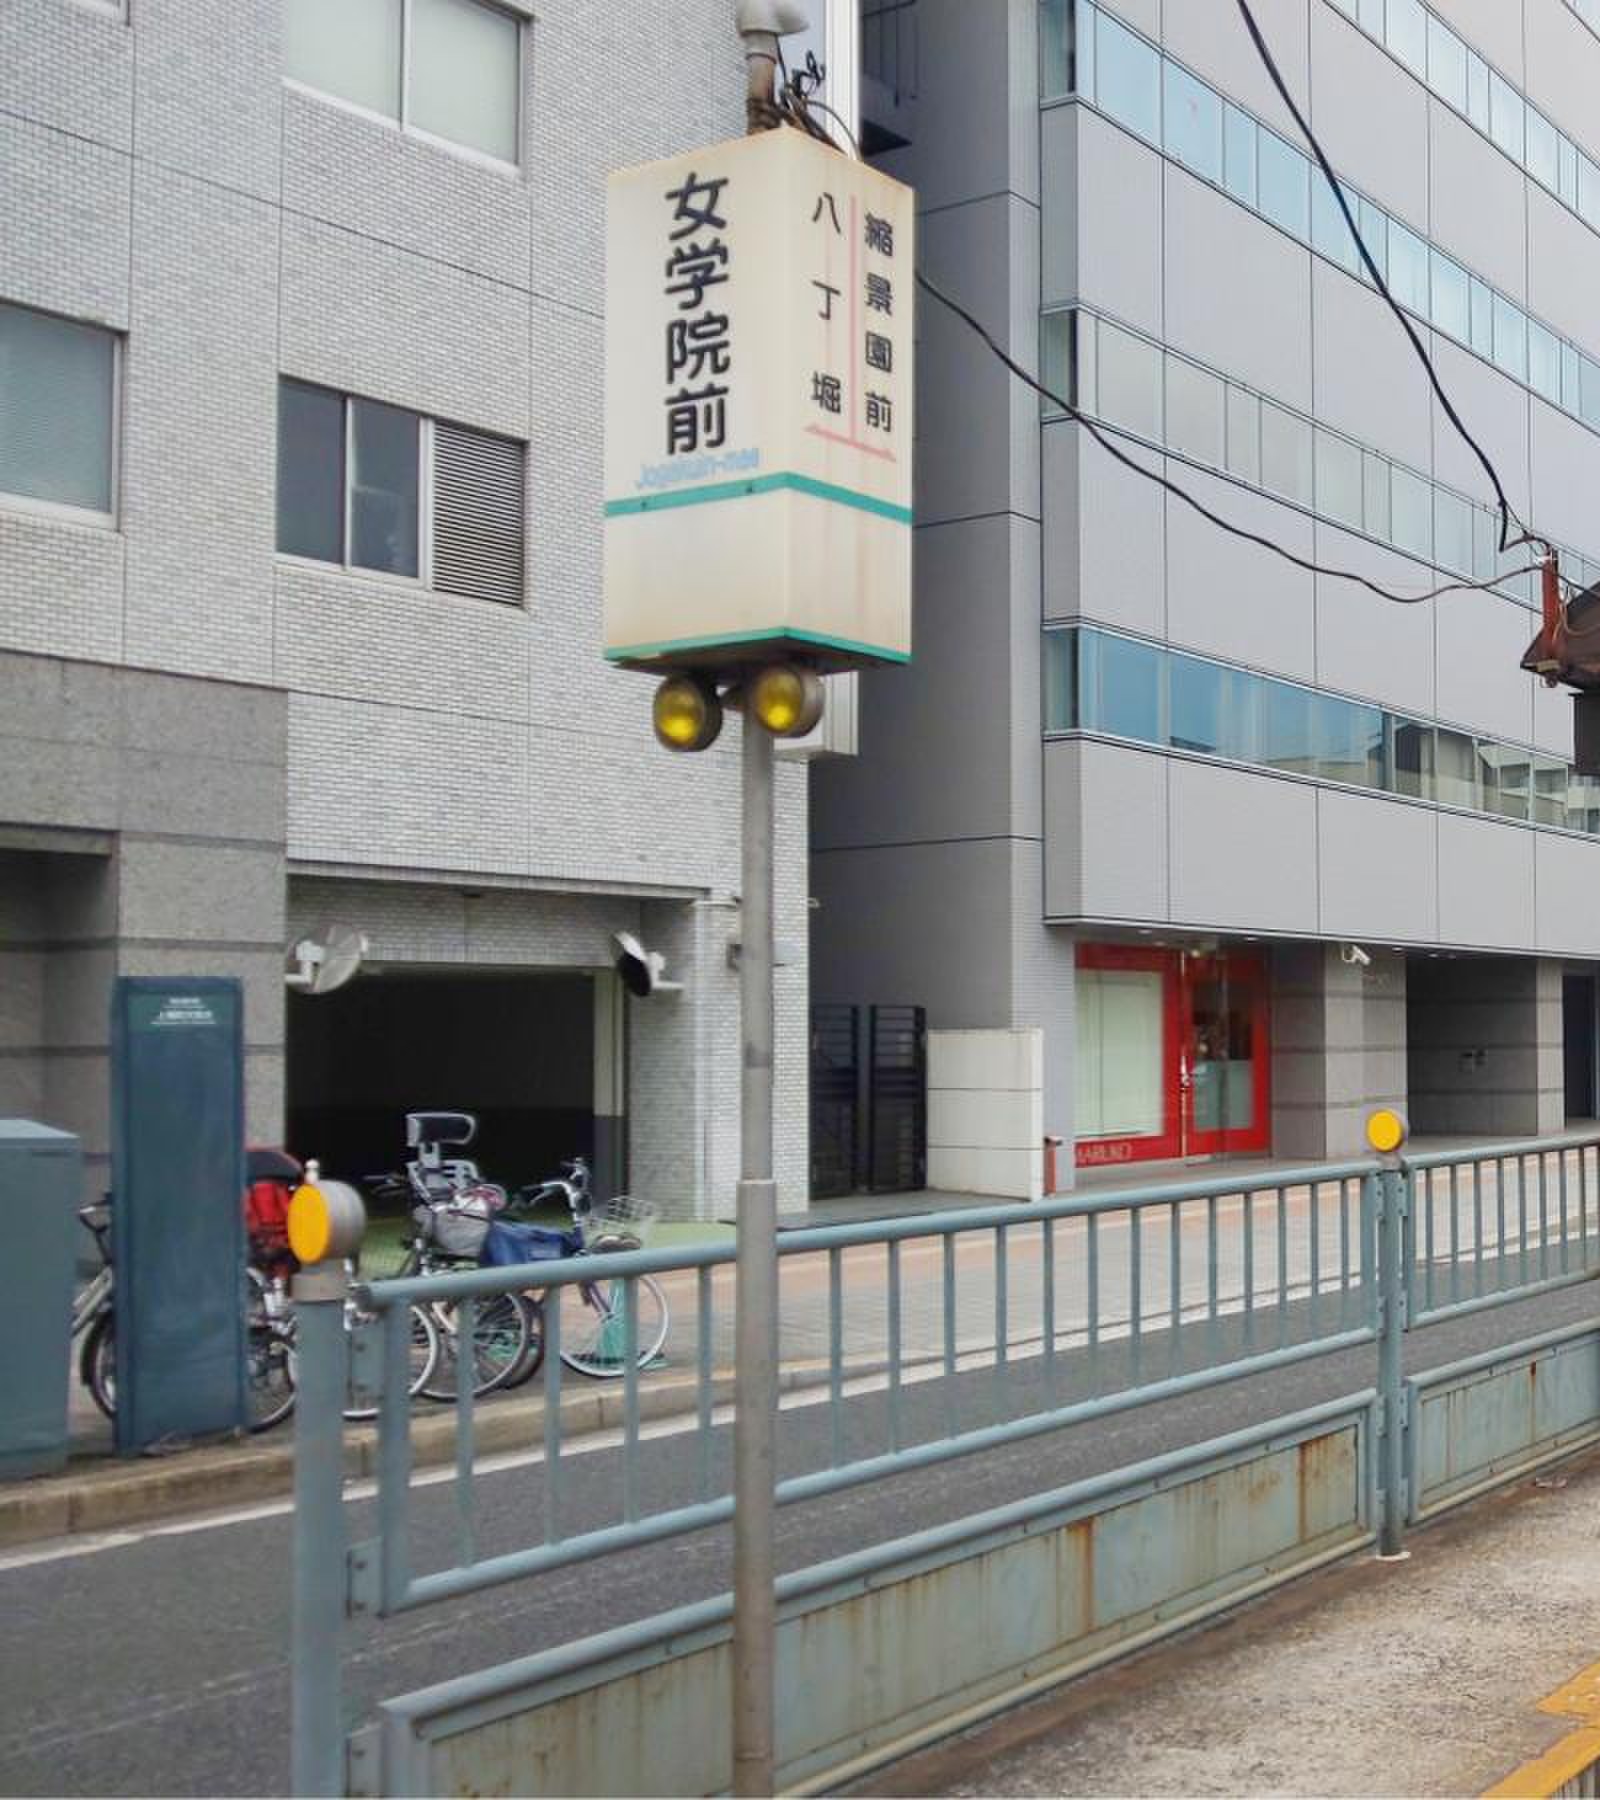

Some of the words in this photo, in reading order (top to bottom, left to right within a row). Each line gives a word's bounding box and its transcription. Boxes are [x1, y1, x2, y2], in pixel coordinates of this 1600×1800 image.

[664, 171, 730, 455] 女学院前
[811, 191, 841, 414] 八丁堀
[863, 213, 893, 432] 縮景園前
